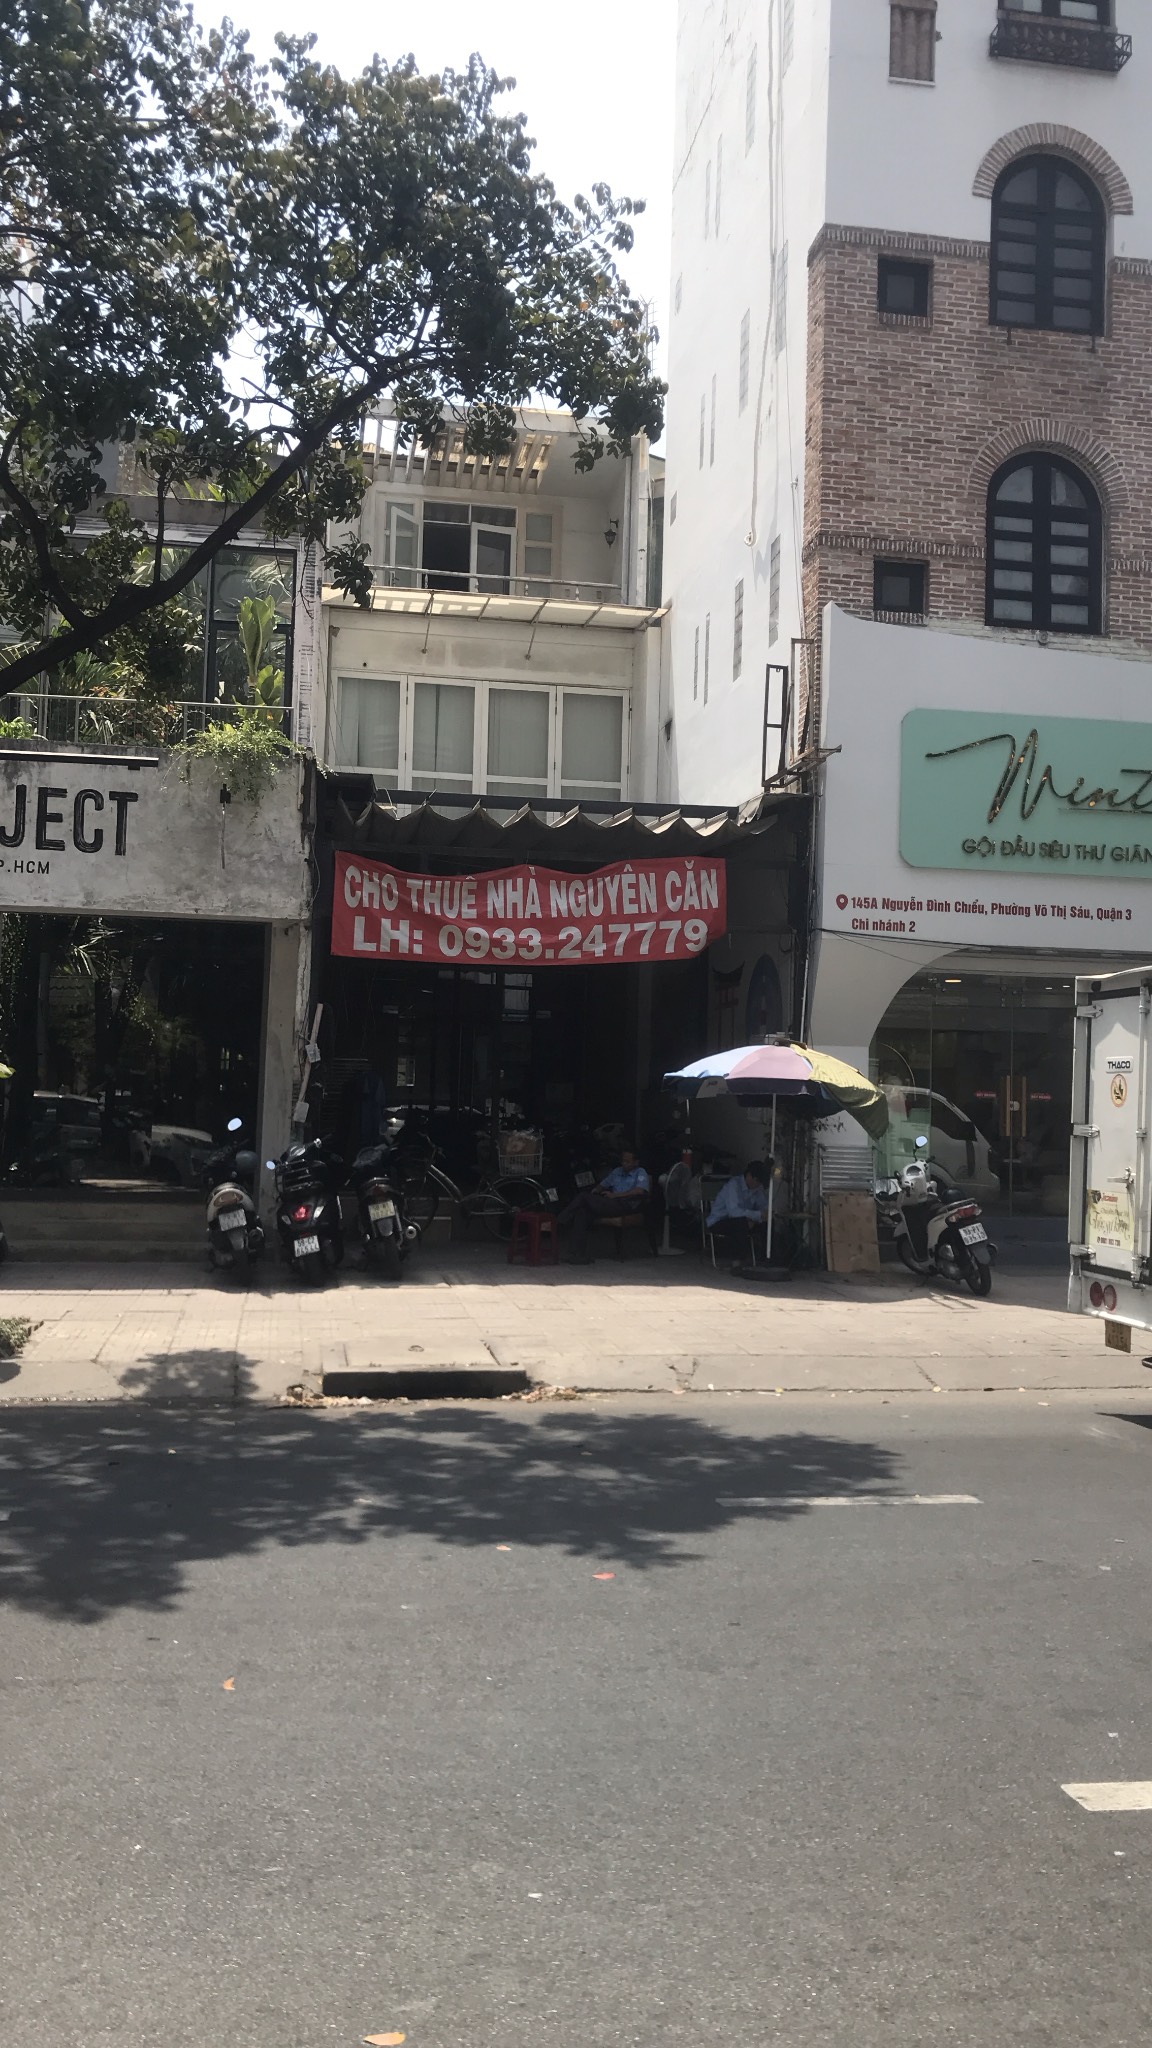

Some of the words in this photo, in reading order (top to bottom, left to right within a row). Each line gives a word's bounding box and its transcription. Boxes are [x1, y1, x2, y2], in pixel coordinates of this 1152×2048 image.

[0, 784, 139, 856] JECT
[962, 836, 996, 858] GỘI
[1074, 843, 1106, 861] THƯ
[344, 865, 398, 911] CHO
[406, 875, 477, 919] THUÊ
[487, 866, 542, 919] NHÀ
[550, 863, 658, 918] NGUYÊN
[664, 859, 719, 912] CĂN
[851, 896, 878, 909] 145A
[882, 896, 923, 912] Nguyễn
[926, 899, 951, 912] Đình
[954, 899, 988, 915] Chiểu,
[991, 902, 1031, 917] Phường
[1035, 904, 1048, 916] Võ
[1051, 905, 1067, 919] Thị
[1070, 906, 1094, 920] Sáu,
[1096, 907, 1123, 921] Quận
[1125, 909, 1132, 920] 3
[851, 917, 869, 930] Chi
[872, 919, 906, 932] nhánh
[908, 921, 916, 932] 2
[353, 915, 423, 954] LH:
[438, 918, 708, 960] 0933.247779
[1107, 1061, 1131, 1069] THACO
